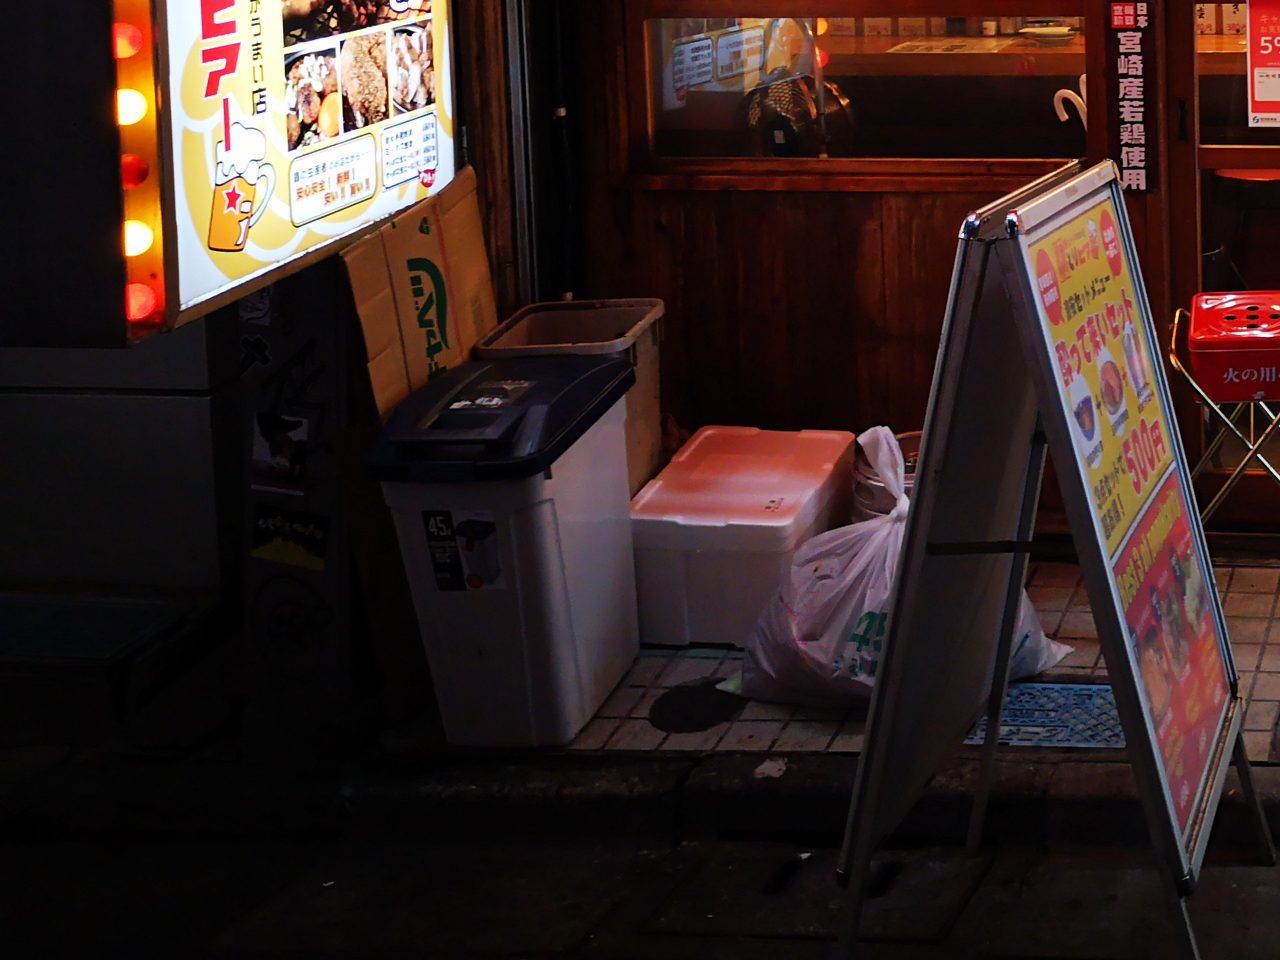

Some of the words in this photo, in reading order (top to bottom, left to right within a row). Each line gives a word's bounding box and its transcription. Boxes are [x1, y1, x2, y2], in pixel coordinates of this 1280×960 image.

[1136, 2, 1148, 28] 日本
[1117, 31, 1147, 190] 宮崎産若鶏使用
[1123, 414, 1168, 495] 500円
